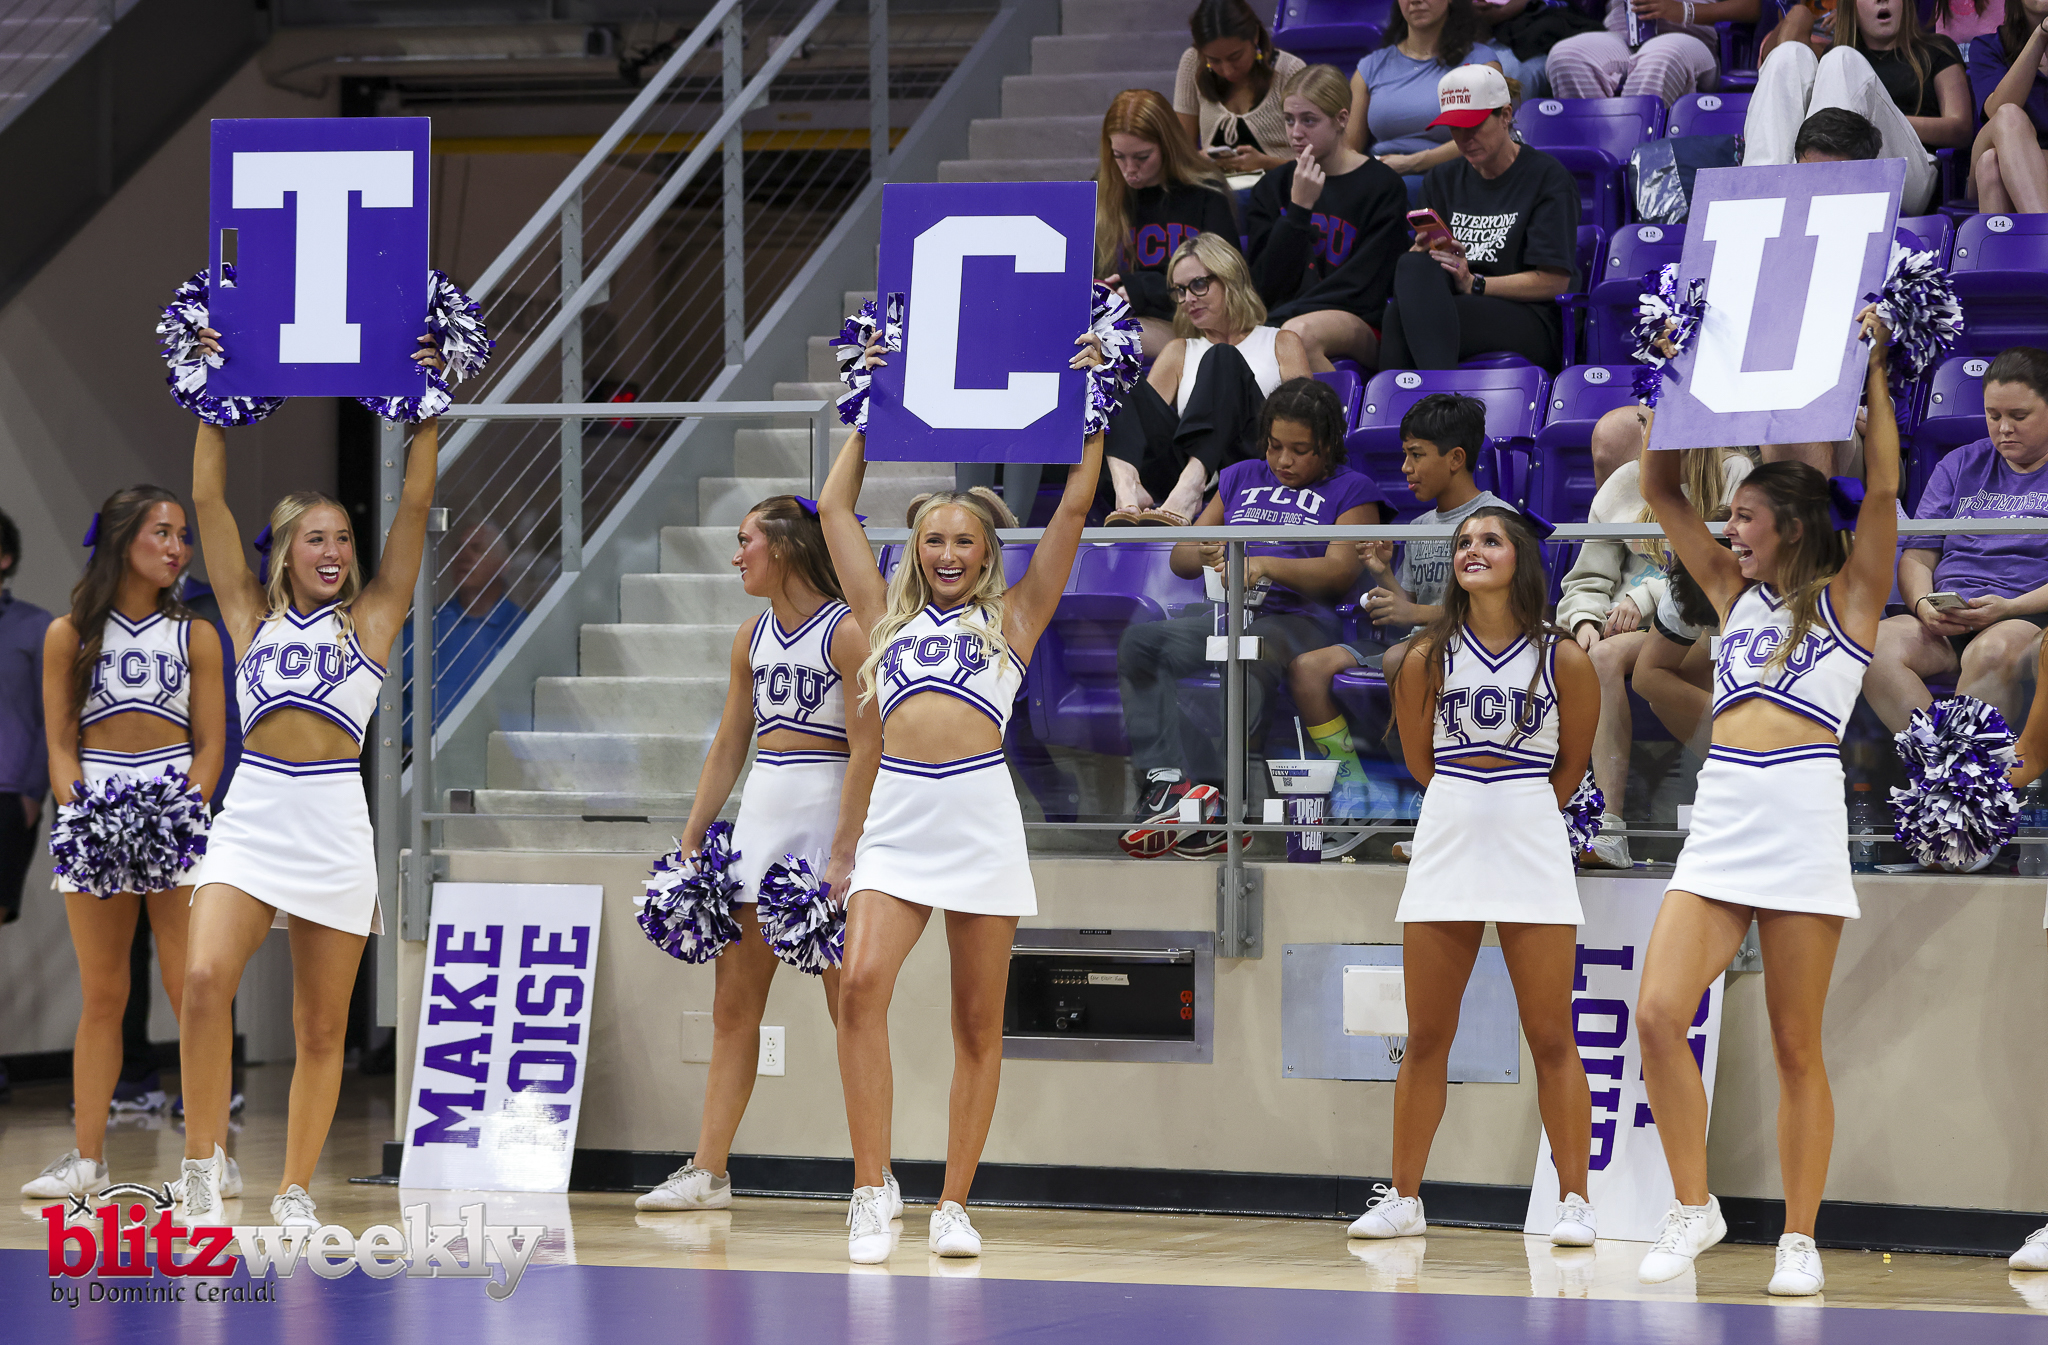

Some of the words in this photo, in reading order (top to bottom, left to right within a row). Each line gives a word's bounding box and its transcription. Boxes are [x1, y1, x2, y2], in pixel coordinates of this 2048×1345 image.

[1546, 104, 1557, 112] 10
[1704, 99, 1714, 107] 11
[1450, 212, 1518, 228] EVERYONE
[1994, 220, 2005, 228] 14
[232, 151, 414, 363] T
[903, 215, 1067, 429] C
[1689, 192, 1890, 414] U
[1402, 376, 1414, 385] 12
[1591, 371, 1603, 380] 13
[1970, 364, 1983, 372] 15
[1240, 485, 1326, 514] TCU
[1244, 507, 1279, 523] HORNED
[1279, 511, 1303, 524] FROGS
[91, 648, 187, 700] TCU
[245, 642, 352, 696] TCU
[881, 633, 993, 686] TCU
[1717, 626, 1824, 684] TCU
[753, 663, 828, 714] TCU
[1436, 685, 1547, 739] TCU
[2020, 814, 2033, 822] FINA
[413, 924, 504, 1148] MAKE
